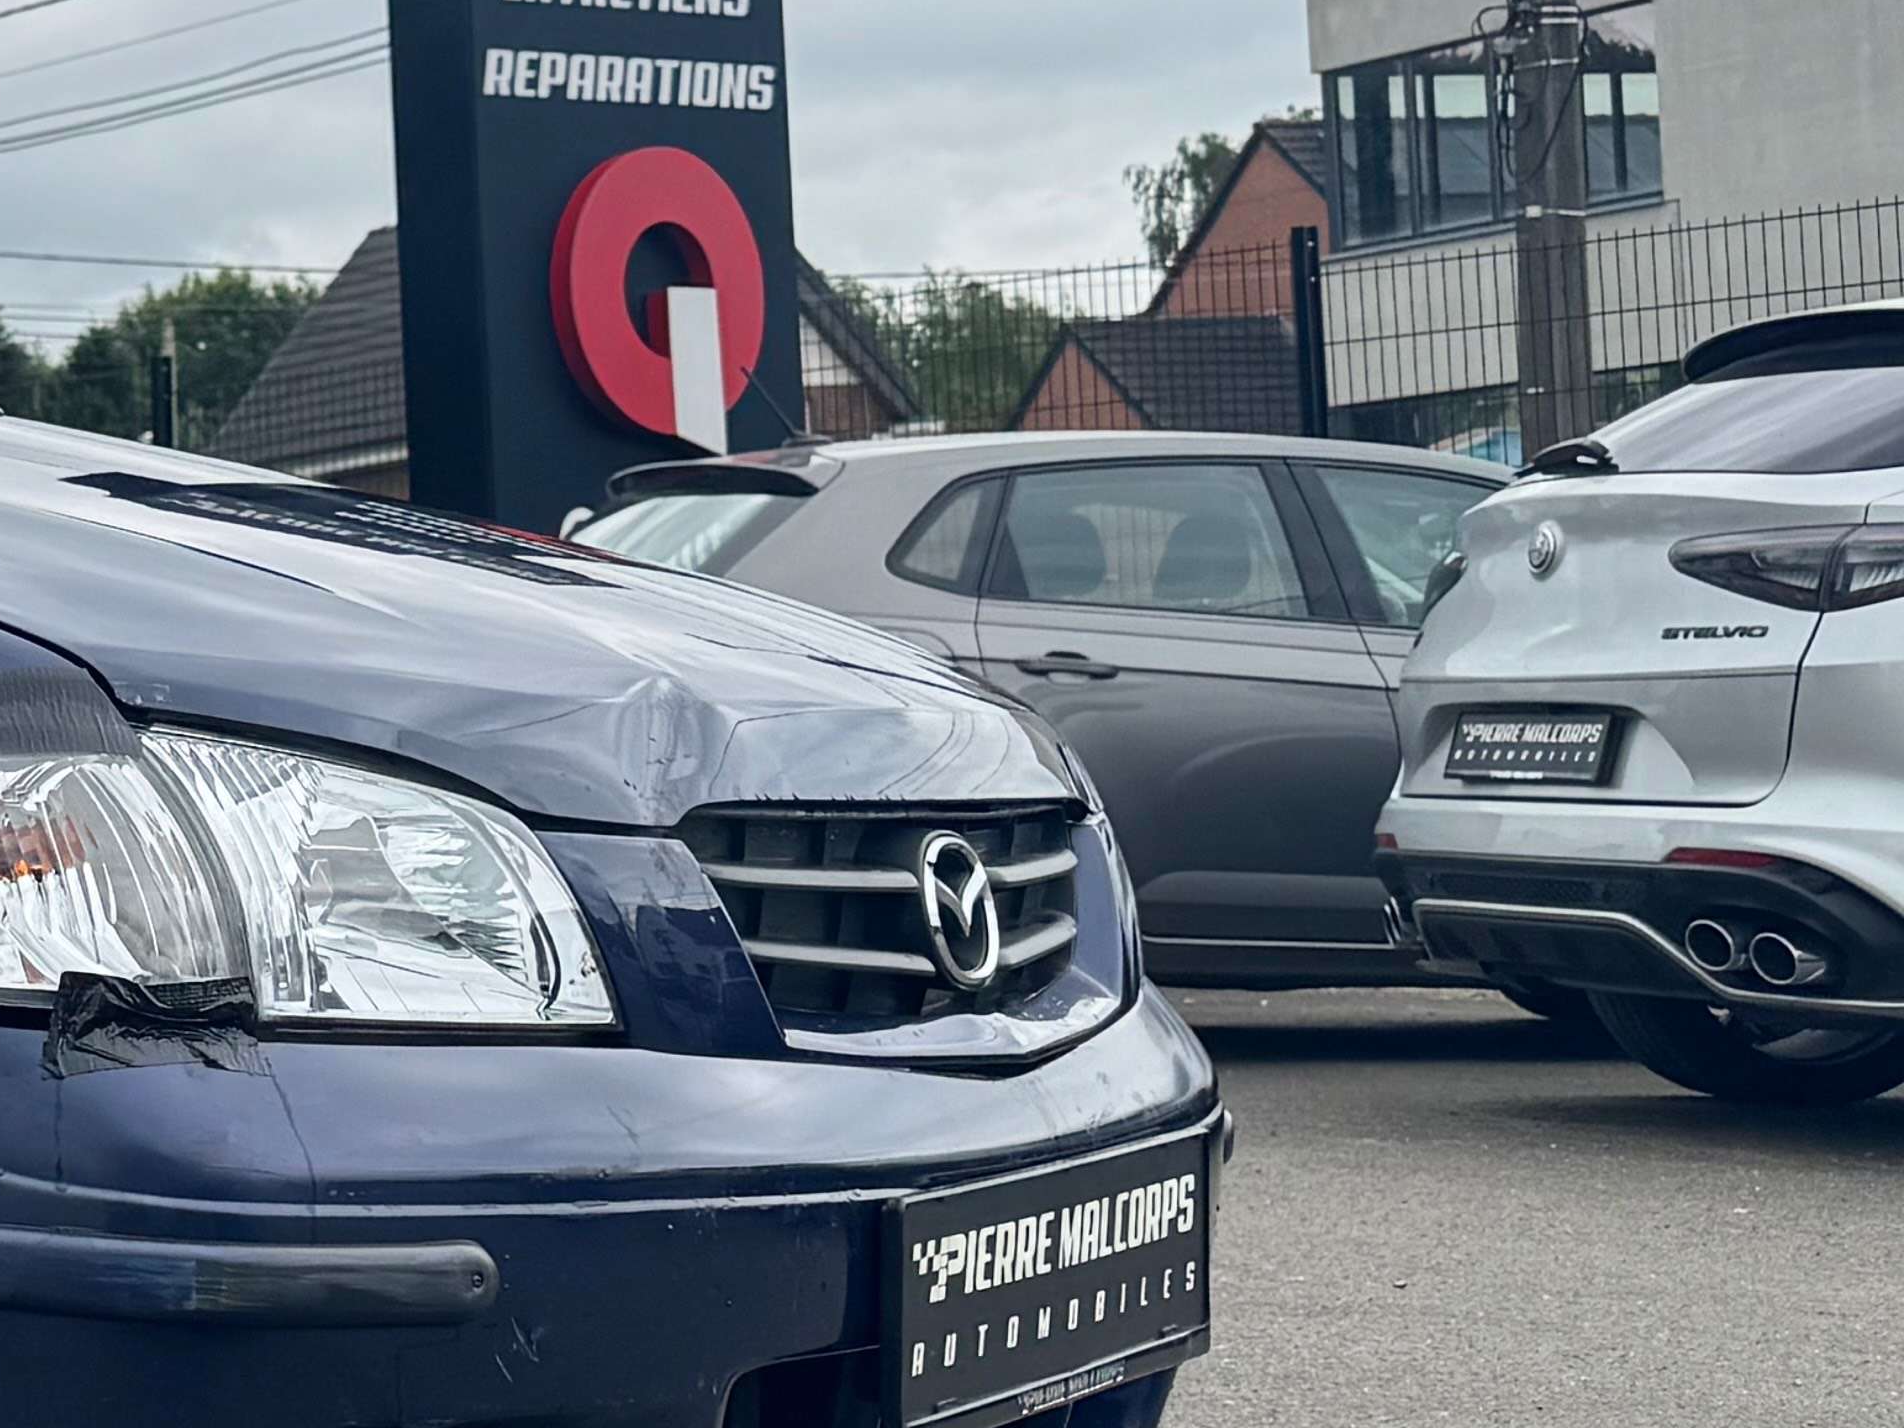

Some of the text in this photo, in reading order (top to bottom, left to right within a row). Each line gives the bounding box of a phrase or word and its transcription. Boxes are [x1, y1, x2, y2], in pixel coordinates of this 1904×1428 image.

[482, 47, 776, 112] REPARATIONS
[1661, 625, 1769, 640] STELVIO
[1466, 723, 1603, 743] PIERRE MALCORPS
[929, 1173, 1196, 1304] PIERRE MALCORPS
[911, 1261, 1196, 1377] AUTOMOBILES
